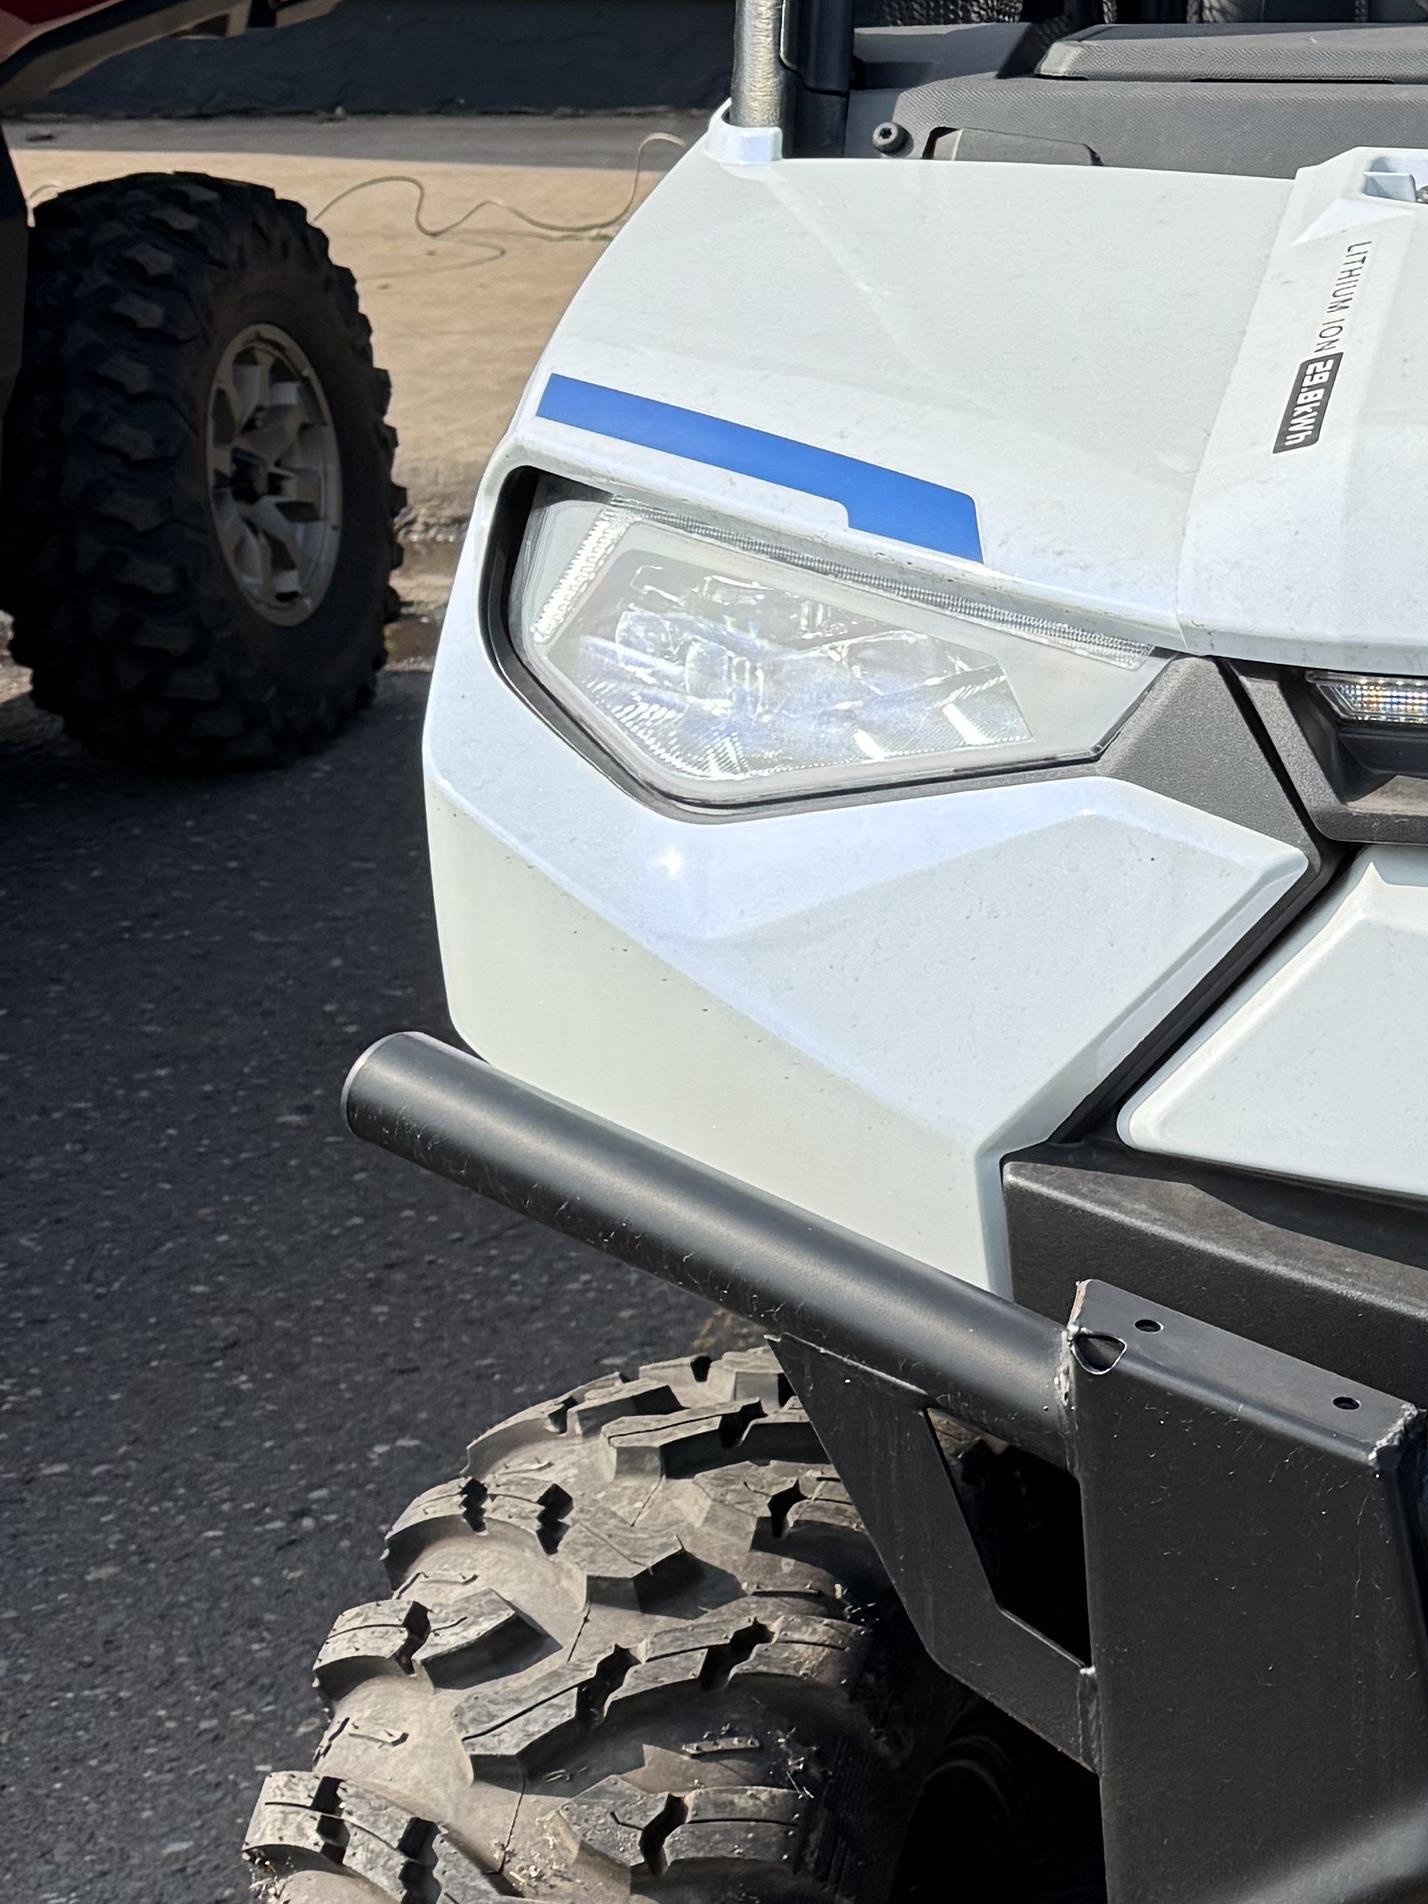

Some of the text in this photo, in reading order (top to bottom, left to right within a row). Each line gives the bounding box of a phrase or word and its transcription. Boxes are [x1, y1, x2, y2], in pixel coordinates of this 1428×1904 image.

[1284, 240, 1373, 446] LITHIUM ION 29.8kWh
